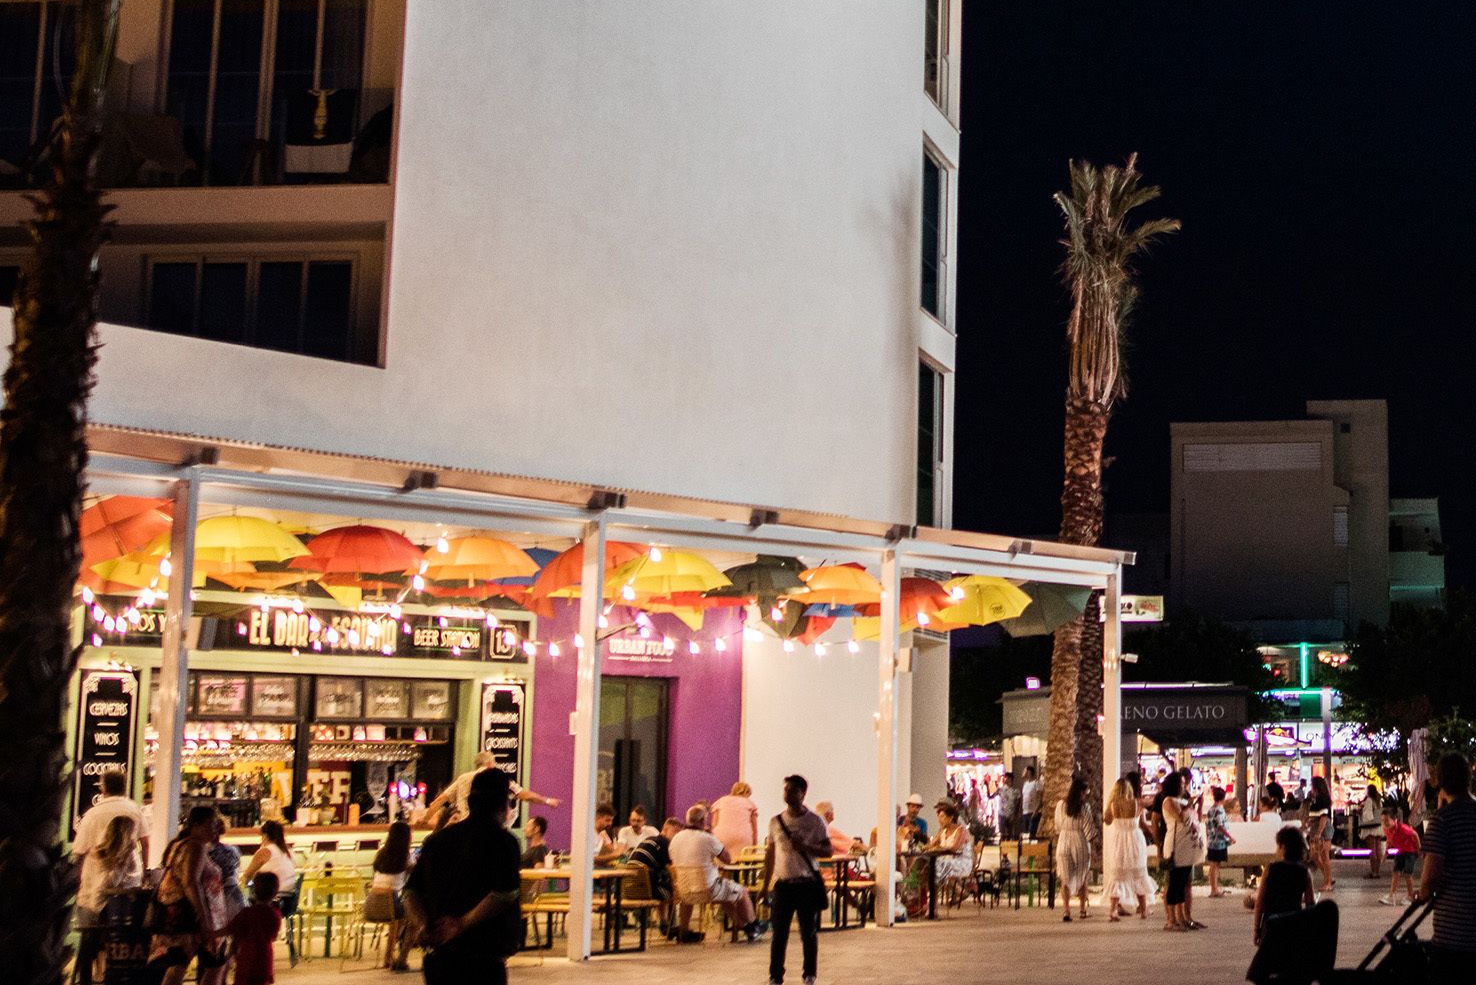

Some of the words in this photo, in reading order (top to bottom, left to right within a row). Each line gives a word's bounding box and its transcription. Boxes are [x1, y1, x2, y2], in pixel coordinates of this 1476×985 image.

[249, 610, 271, 645] EL
[274, 610, 308, 647] BAR
[413, 629, 439, 647] BEER
[1124, 705, 1158, 721] ENO
[1163, 704, 1225, 720] GELATO
[94, 732, 120, 746] VINOS
